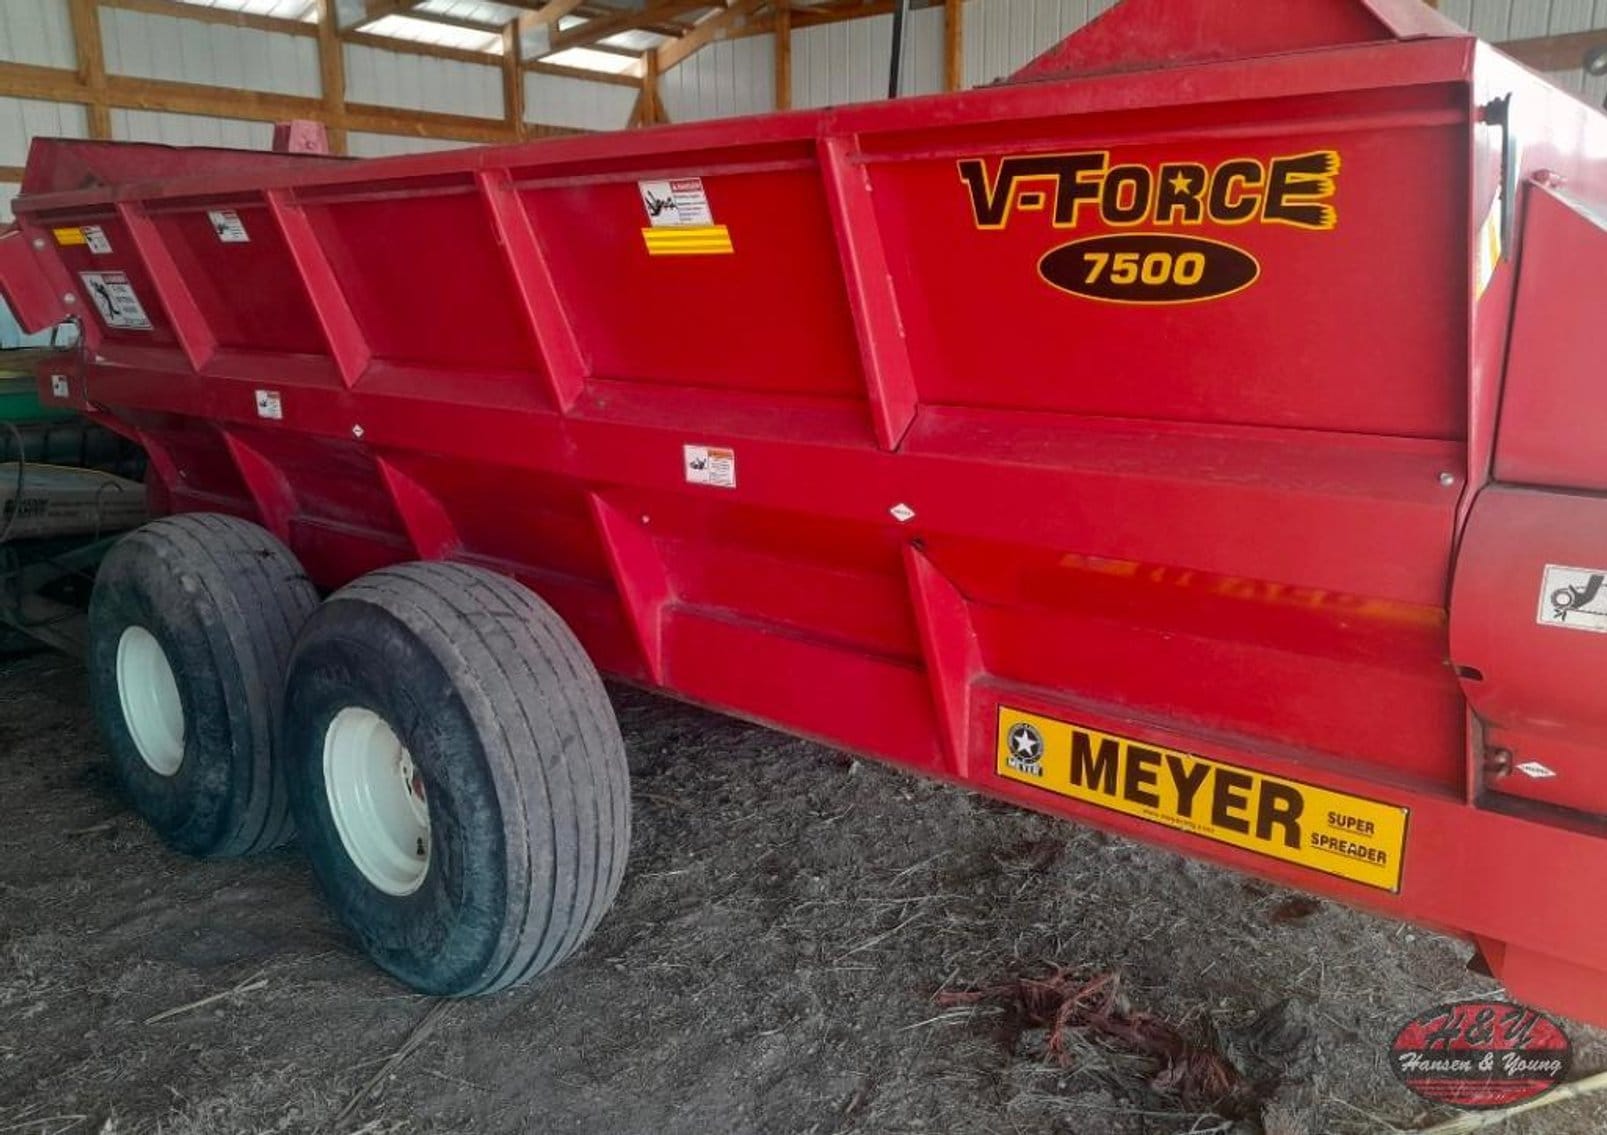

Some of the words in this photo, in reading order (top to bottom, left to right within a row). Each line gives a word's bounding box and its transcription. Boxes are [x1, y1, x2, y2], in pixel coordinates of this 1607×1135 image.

[957, 151, 1341, 230] V-FORCE
[1083, 252, 1205, 285] 7500
[1069, 730, 1305, 850] MEYER
[1327, 811, 1375, 834] SUPER
[1310, 832, 1387, 863] SPREADER
